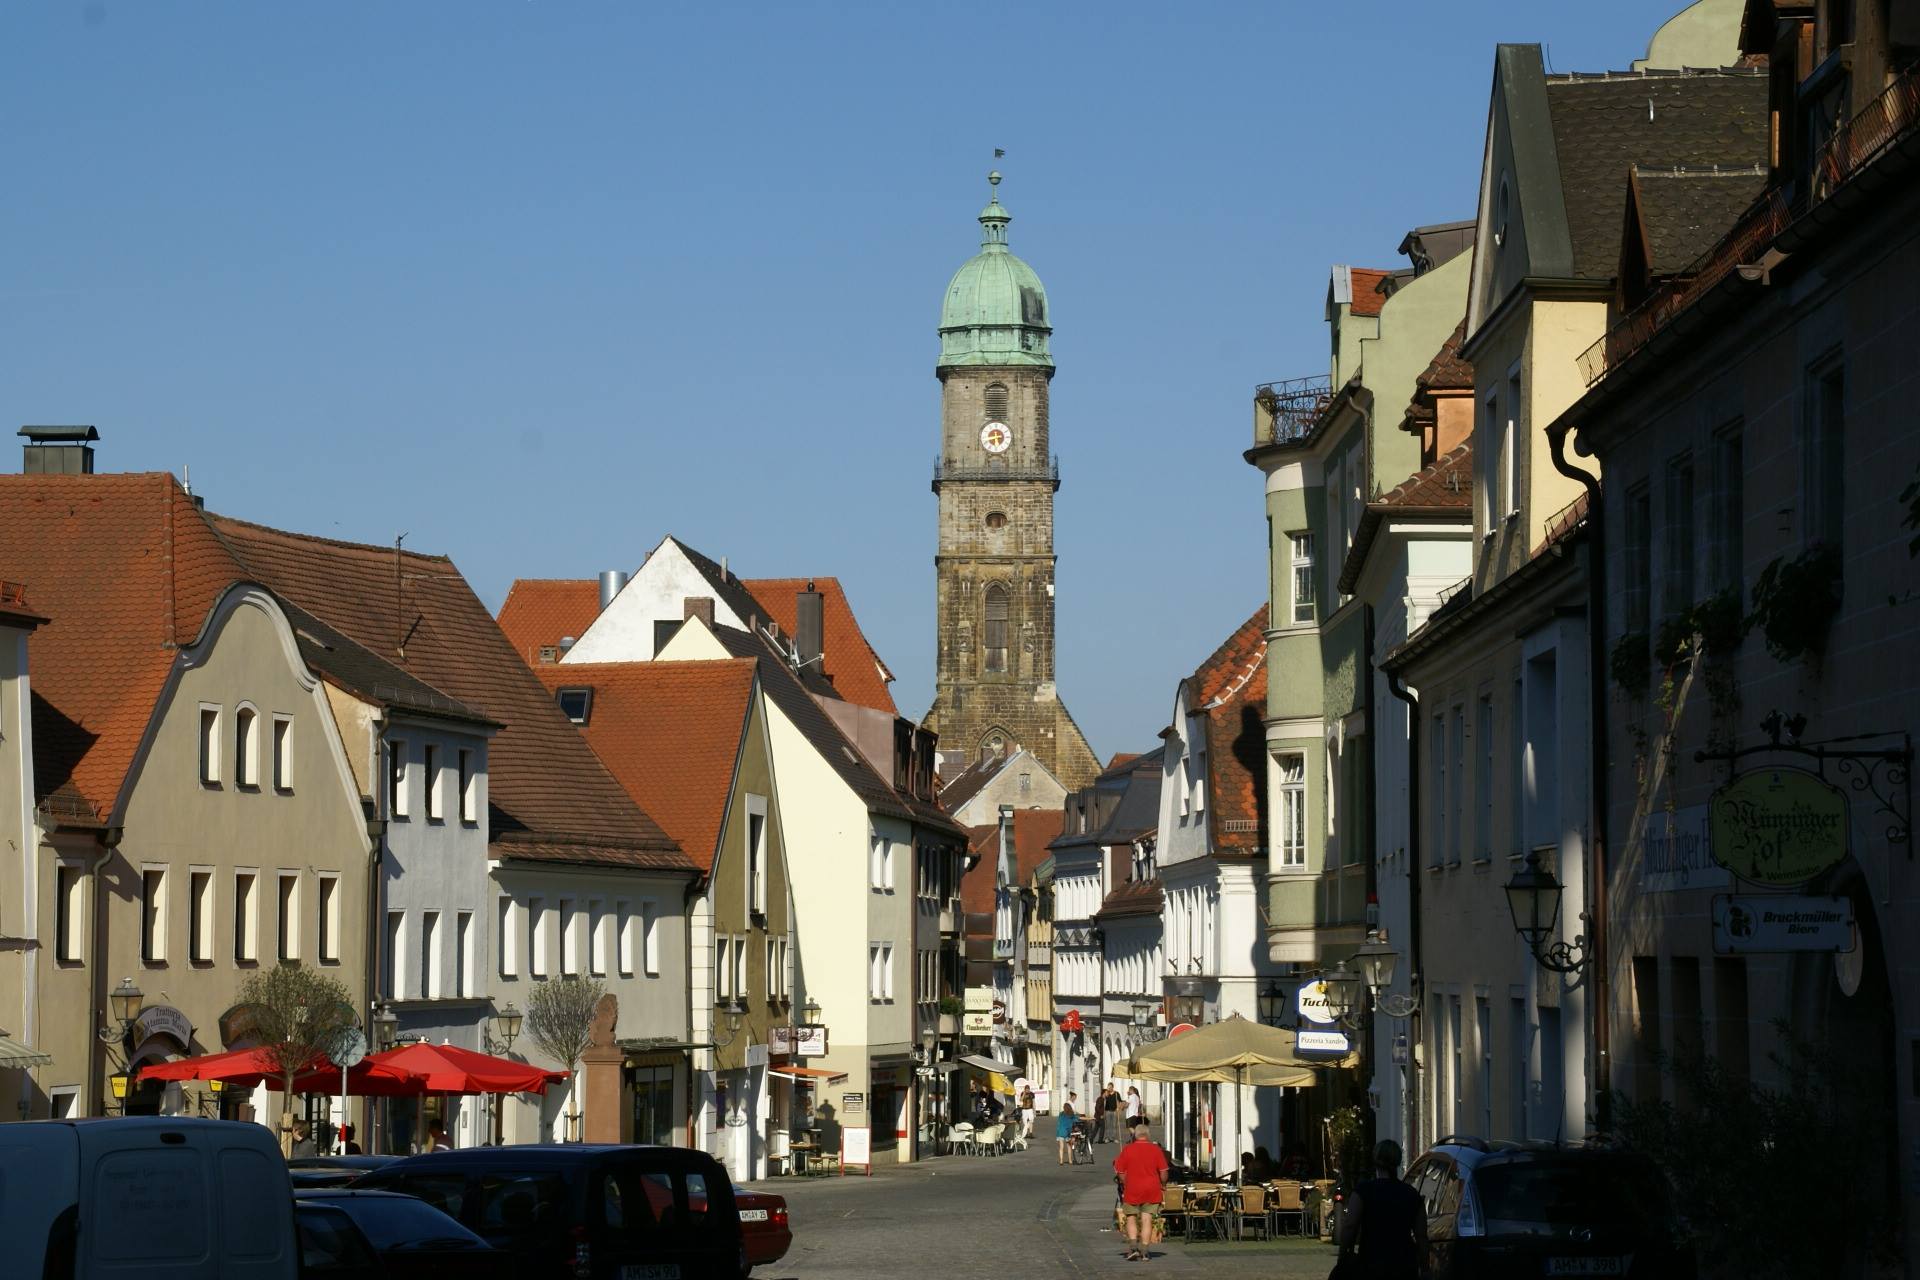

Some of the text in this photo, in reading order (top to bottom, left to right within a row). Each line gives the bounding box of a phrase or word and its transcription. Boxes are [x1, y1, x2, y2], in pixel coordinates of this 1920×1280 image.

[1720, 799, 1841, 833] Münzinger
[1766, 865, 1821, 881] Weinstube
[1763, 910, 1843, 923] Bruckmüller
[1787, 924, 1819, 934] Biere
[155, 1007, 181, 1021] Trattoria
[1301, 1036, 1346, 1045] Pizzeria Sandro
